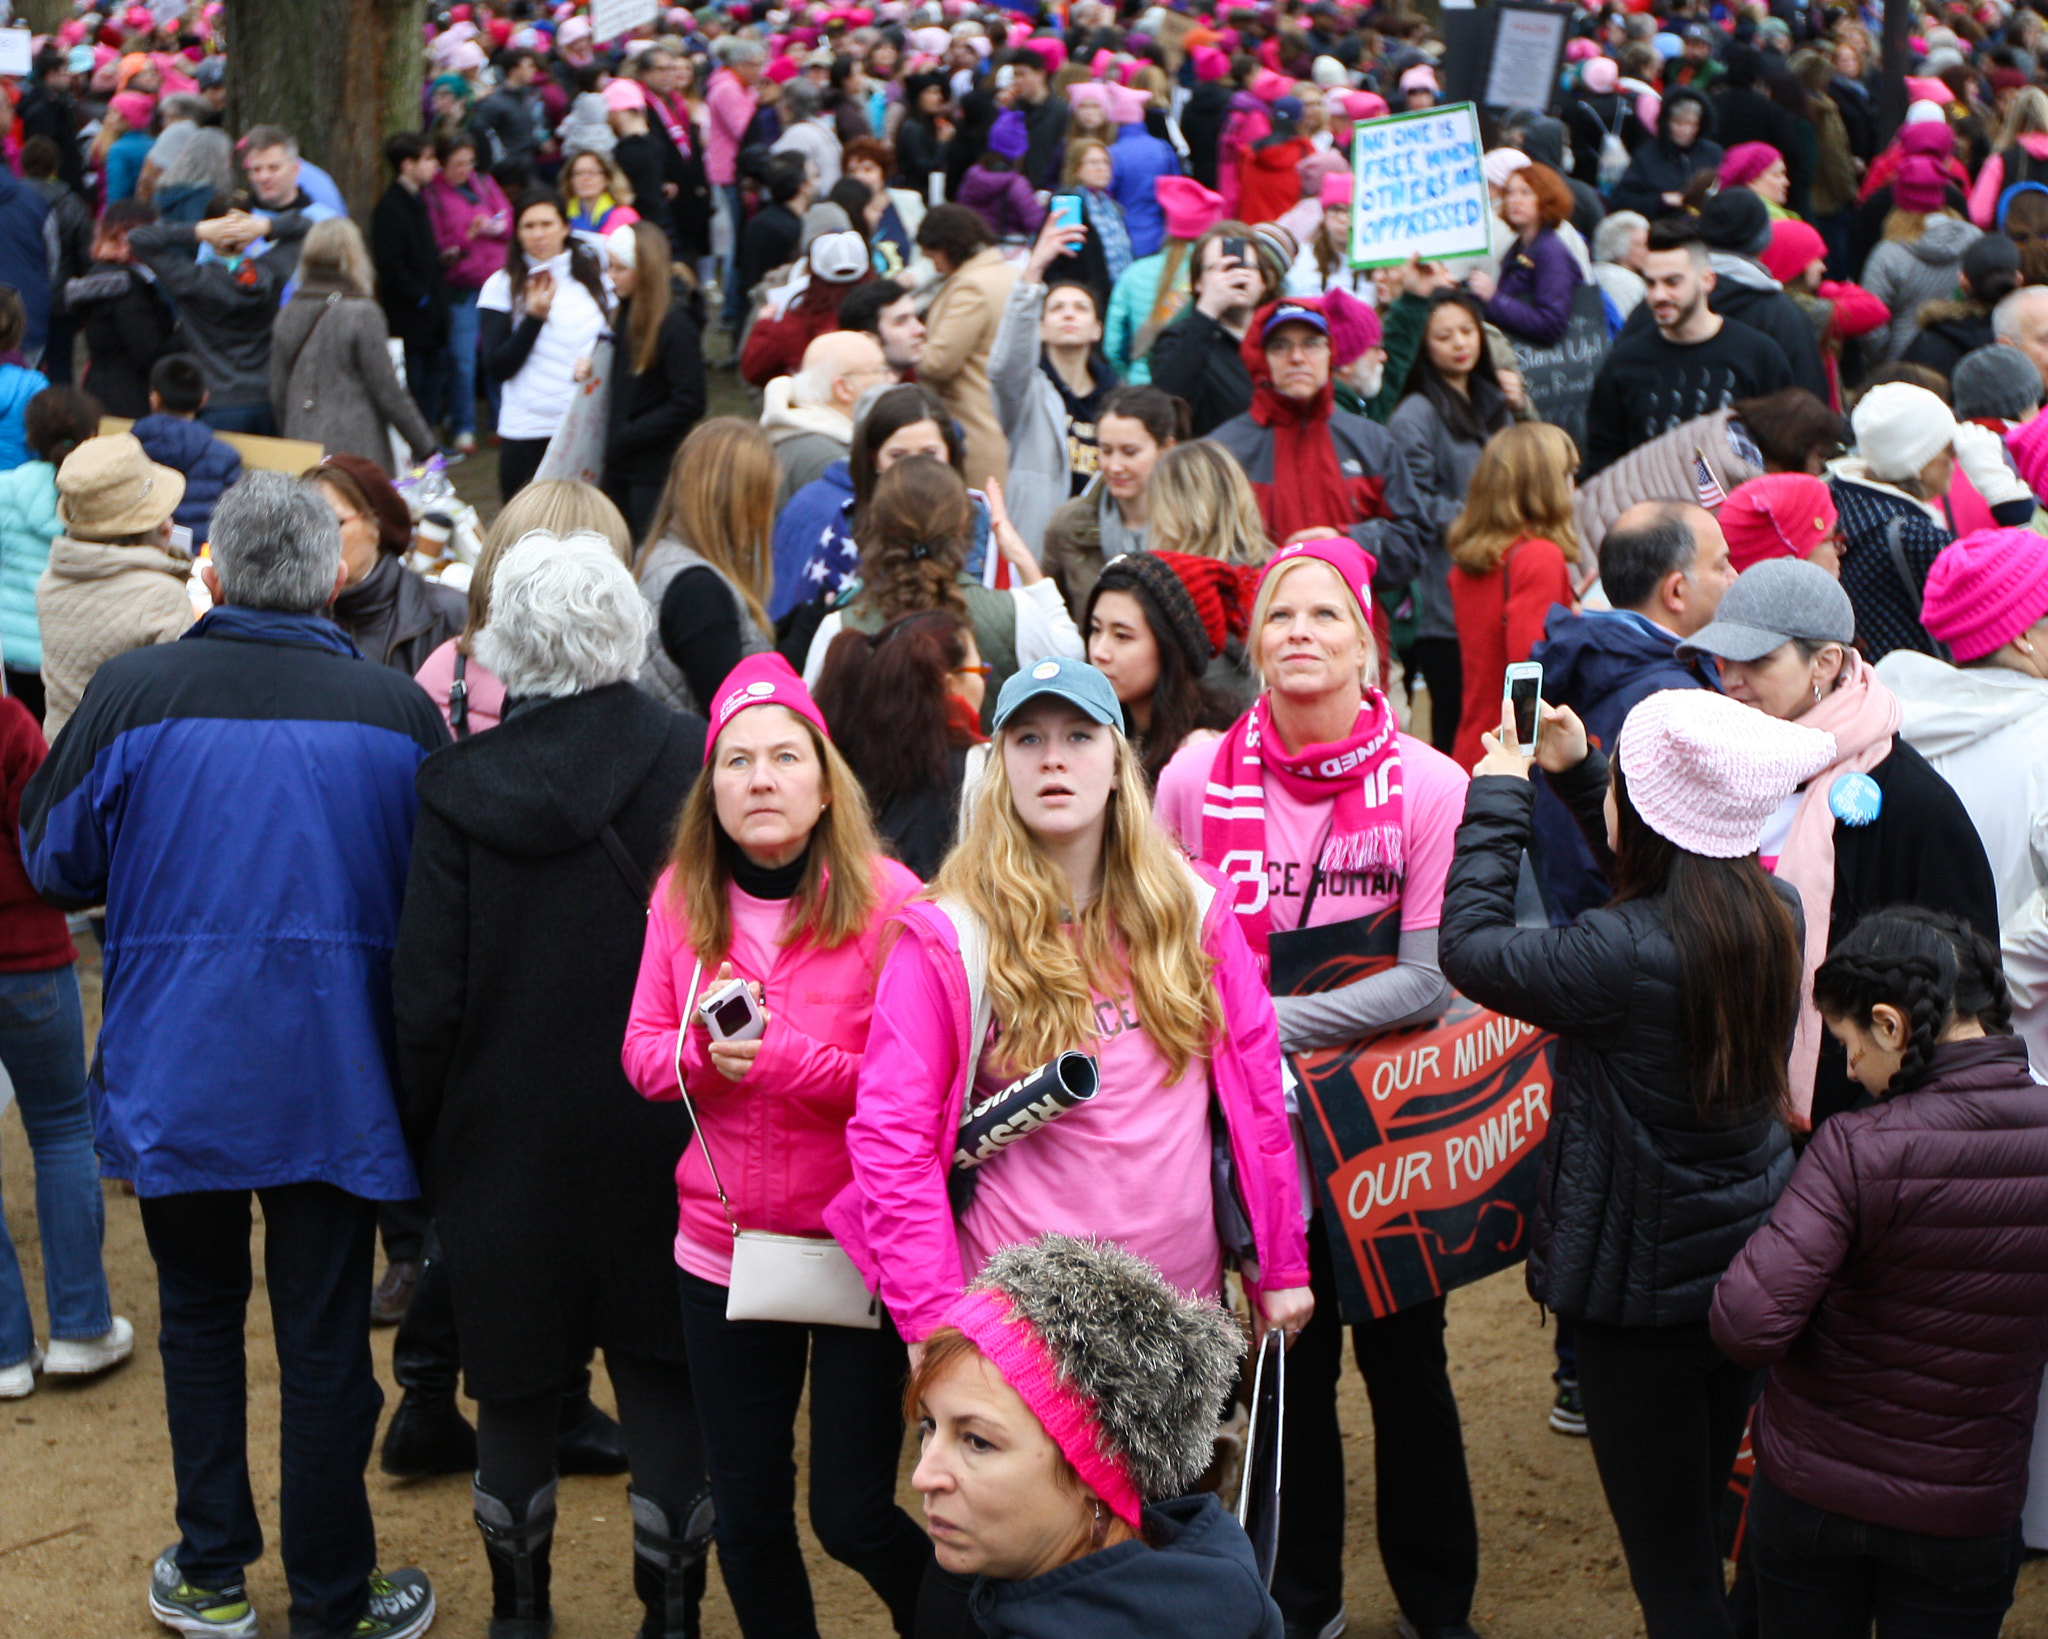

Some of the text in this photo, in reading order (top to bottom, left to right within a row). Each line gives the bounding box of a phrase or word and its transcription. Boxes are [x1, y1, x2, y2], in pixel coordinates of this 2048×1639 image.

[1362, 119, 1455, 152] NO ONE IS
[1363, 149, 1418, 184] FREE
[1361, 171, 1448, 212] OTHERS
[1361, 199, 1480, 245] OPPRESSED
[1371, 1046, 1441, 1101] OUR
[1347, 1082, 1550, 1220] OUR POWER
